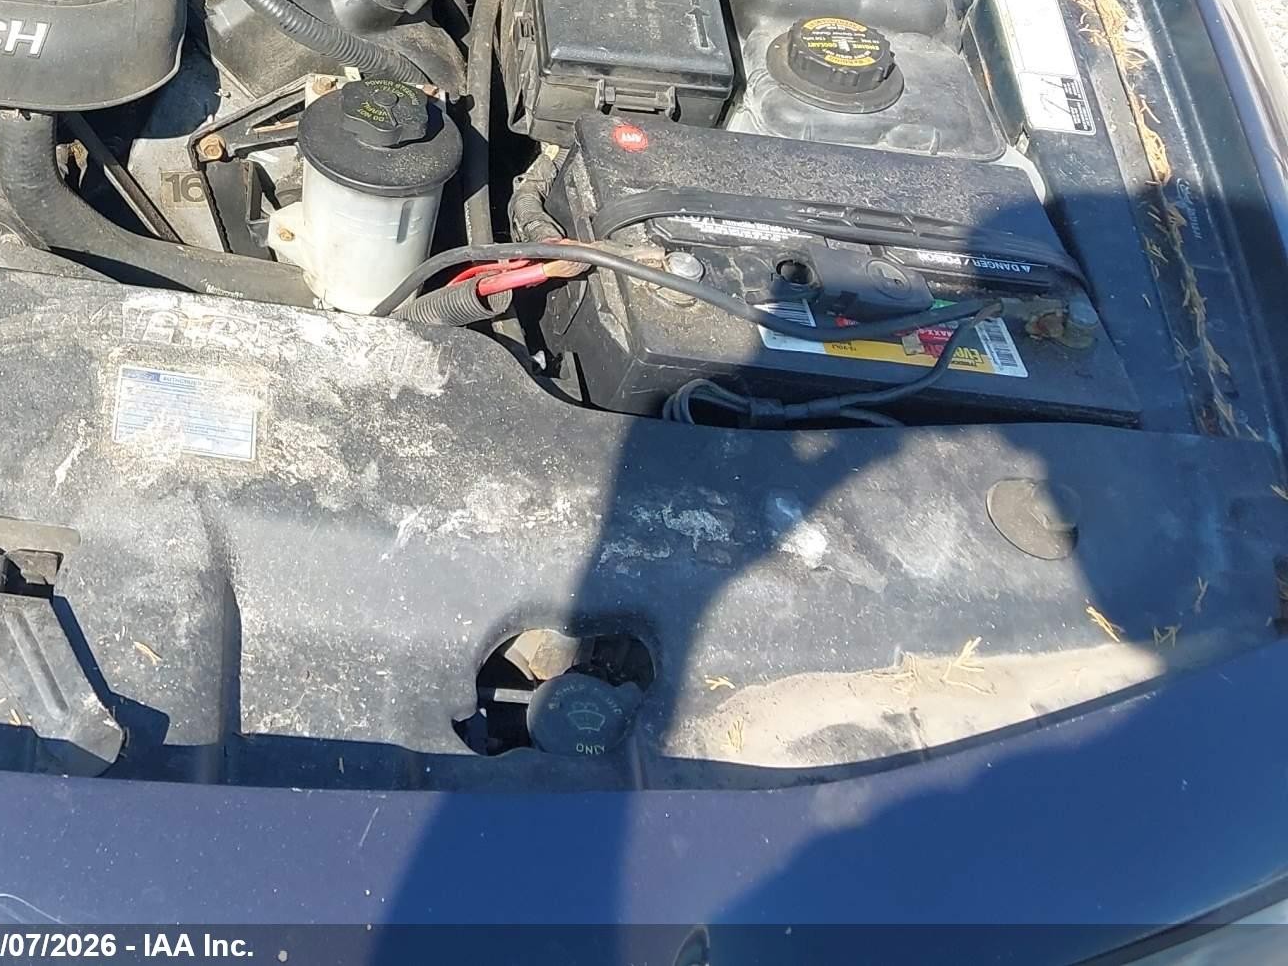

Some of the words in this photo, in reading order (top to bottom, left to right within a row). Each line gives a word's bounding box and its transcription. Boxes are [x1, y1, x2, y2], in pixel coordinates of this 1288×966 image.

[364, 79, 394, 87] POWER
[165, 173, 205, 202] 16
[917, 251, 962, 266] POISON
[971, 258, 1021, 273] DANGER
[575, 742, 605, 755] ONLY
